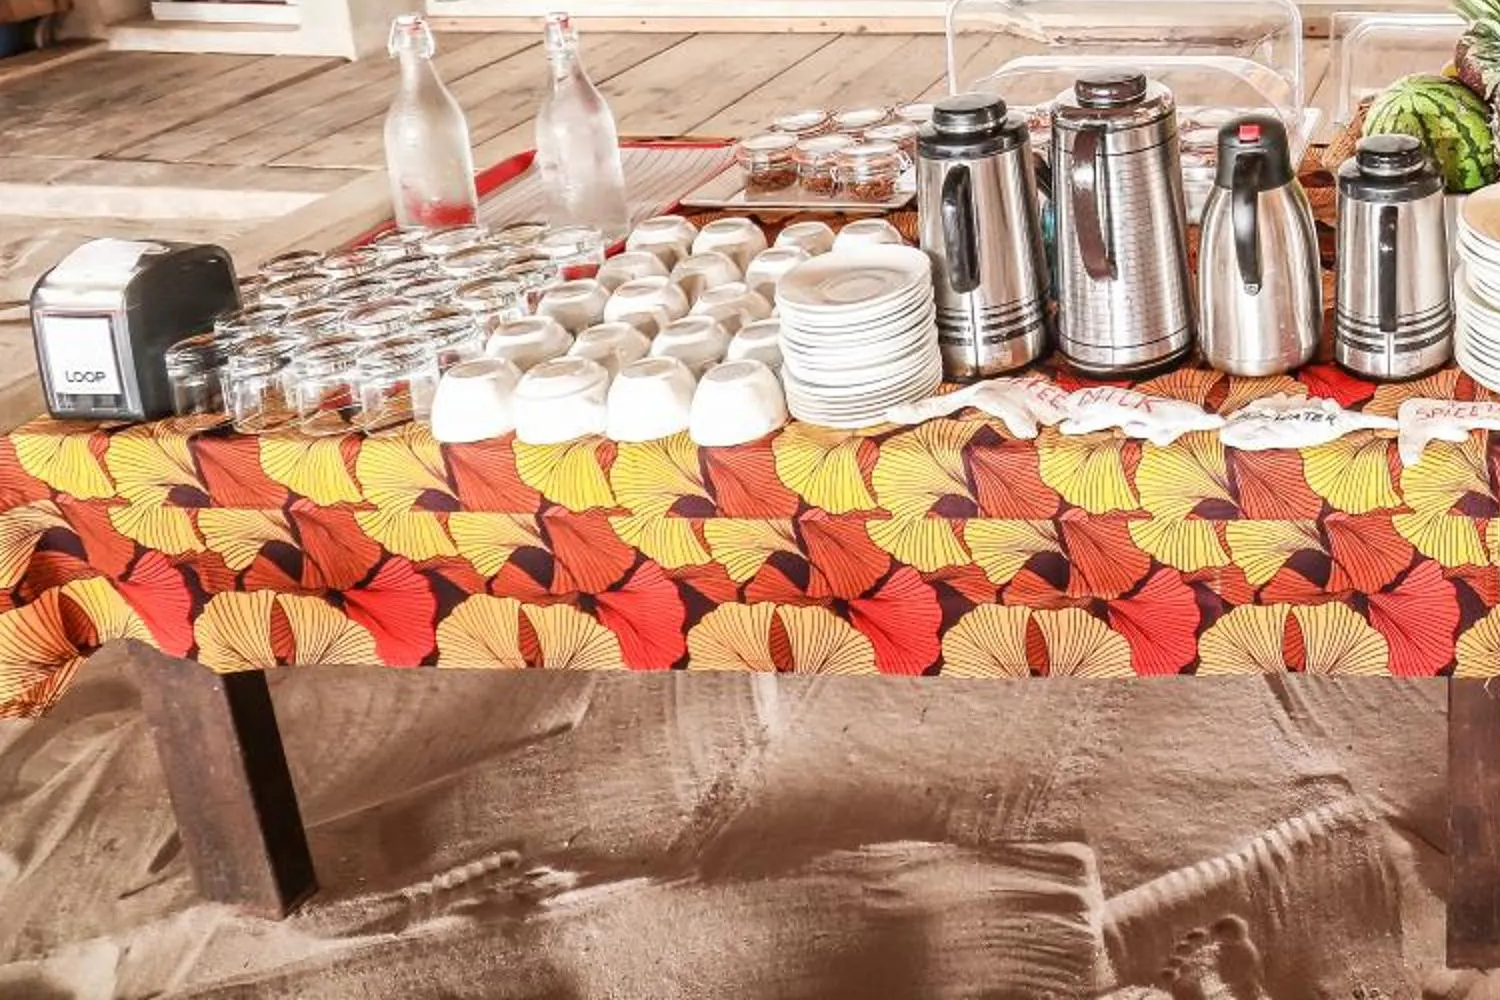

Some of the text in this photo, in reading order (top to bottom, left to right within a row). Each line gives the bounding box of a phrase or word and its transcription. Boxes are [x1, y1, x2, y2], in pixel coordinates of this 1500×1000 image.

[65, 371, 106, 383] LOOP
[1078, 388, 1166, 413] MILK
[1416, 403, 1479, 421] SPICE
